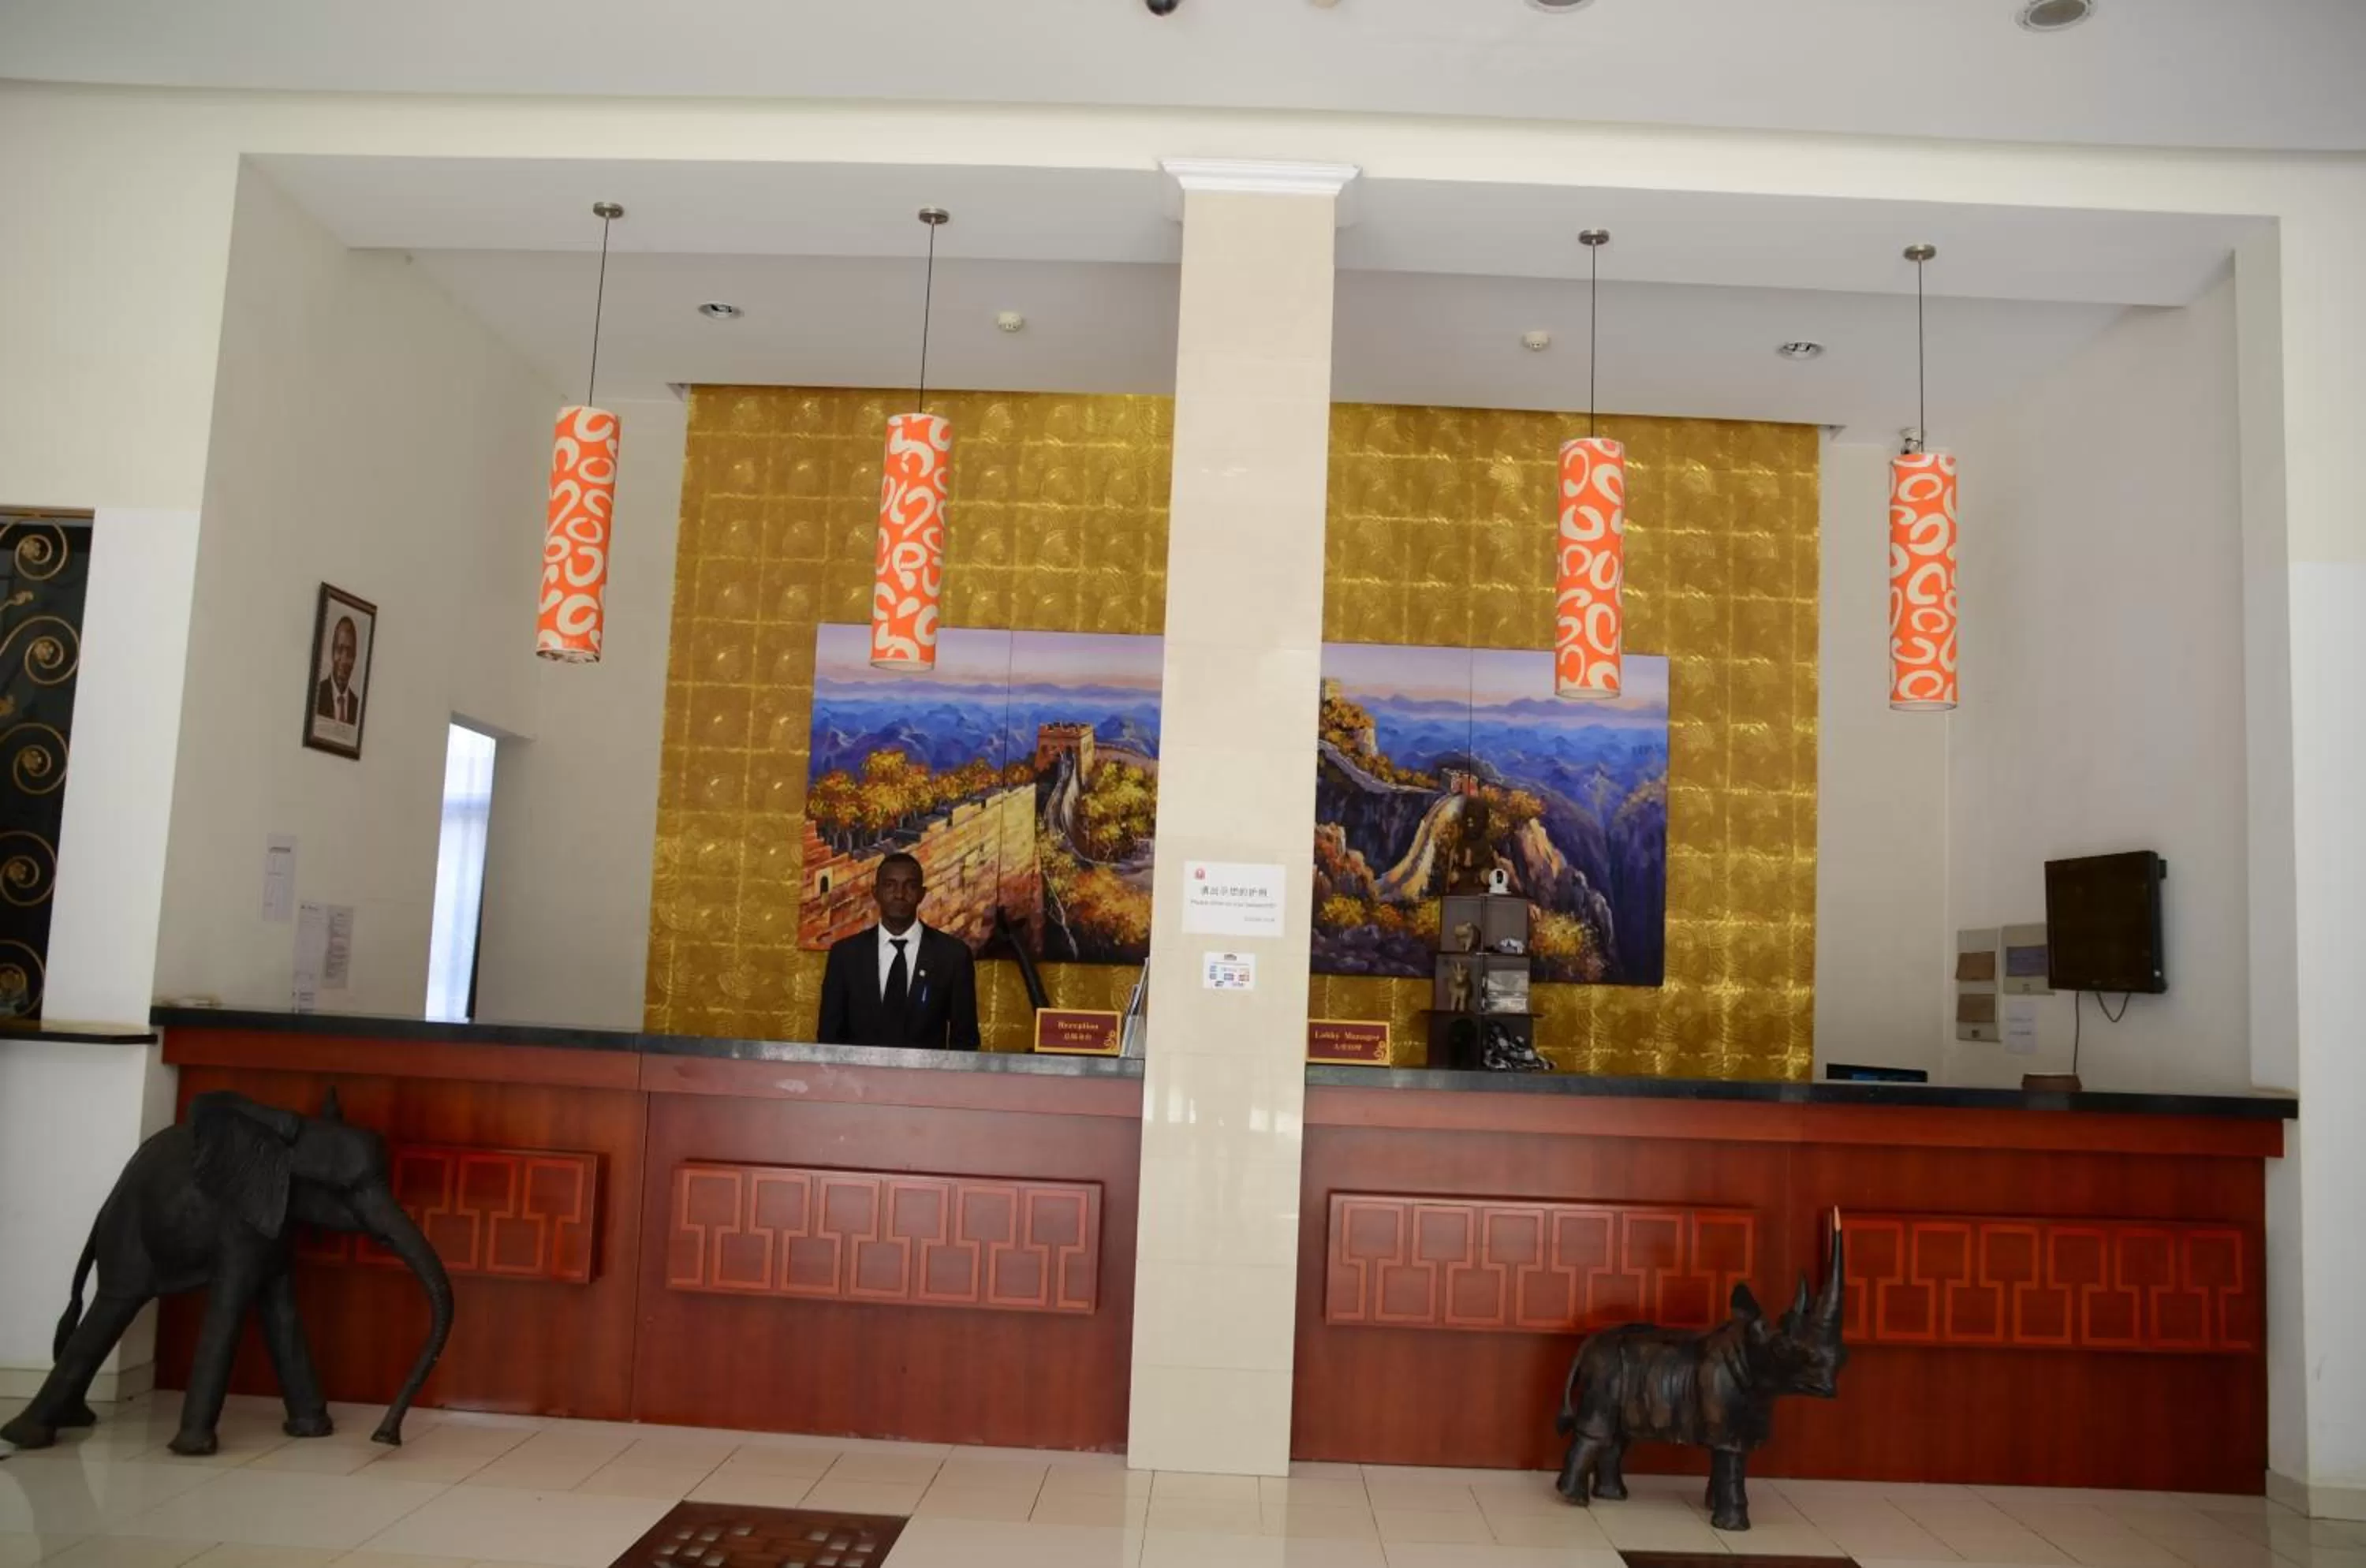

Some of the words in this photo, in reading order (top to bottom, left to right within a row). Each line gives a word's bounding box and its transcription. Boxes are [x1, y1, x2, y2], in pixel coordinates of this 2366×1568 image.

[1058, 1021, 1099, 1030] Reception
[1315, 1031, 1340, 1040] Lobby
[1345, 1032, 1380, 1041] Manager
